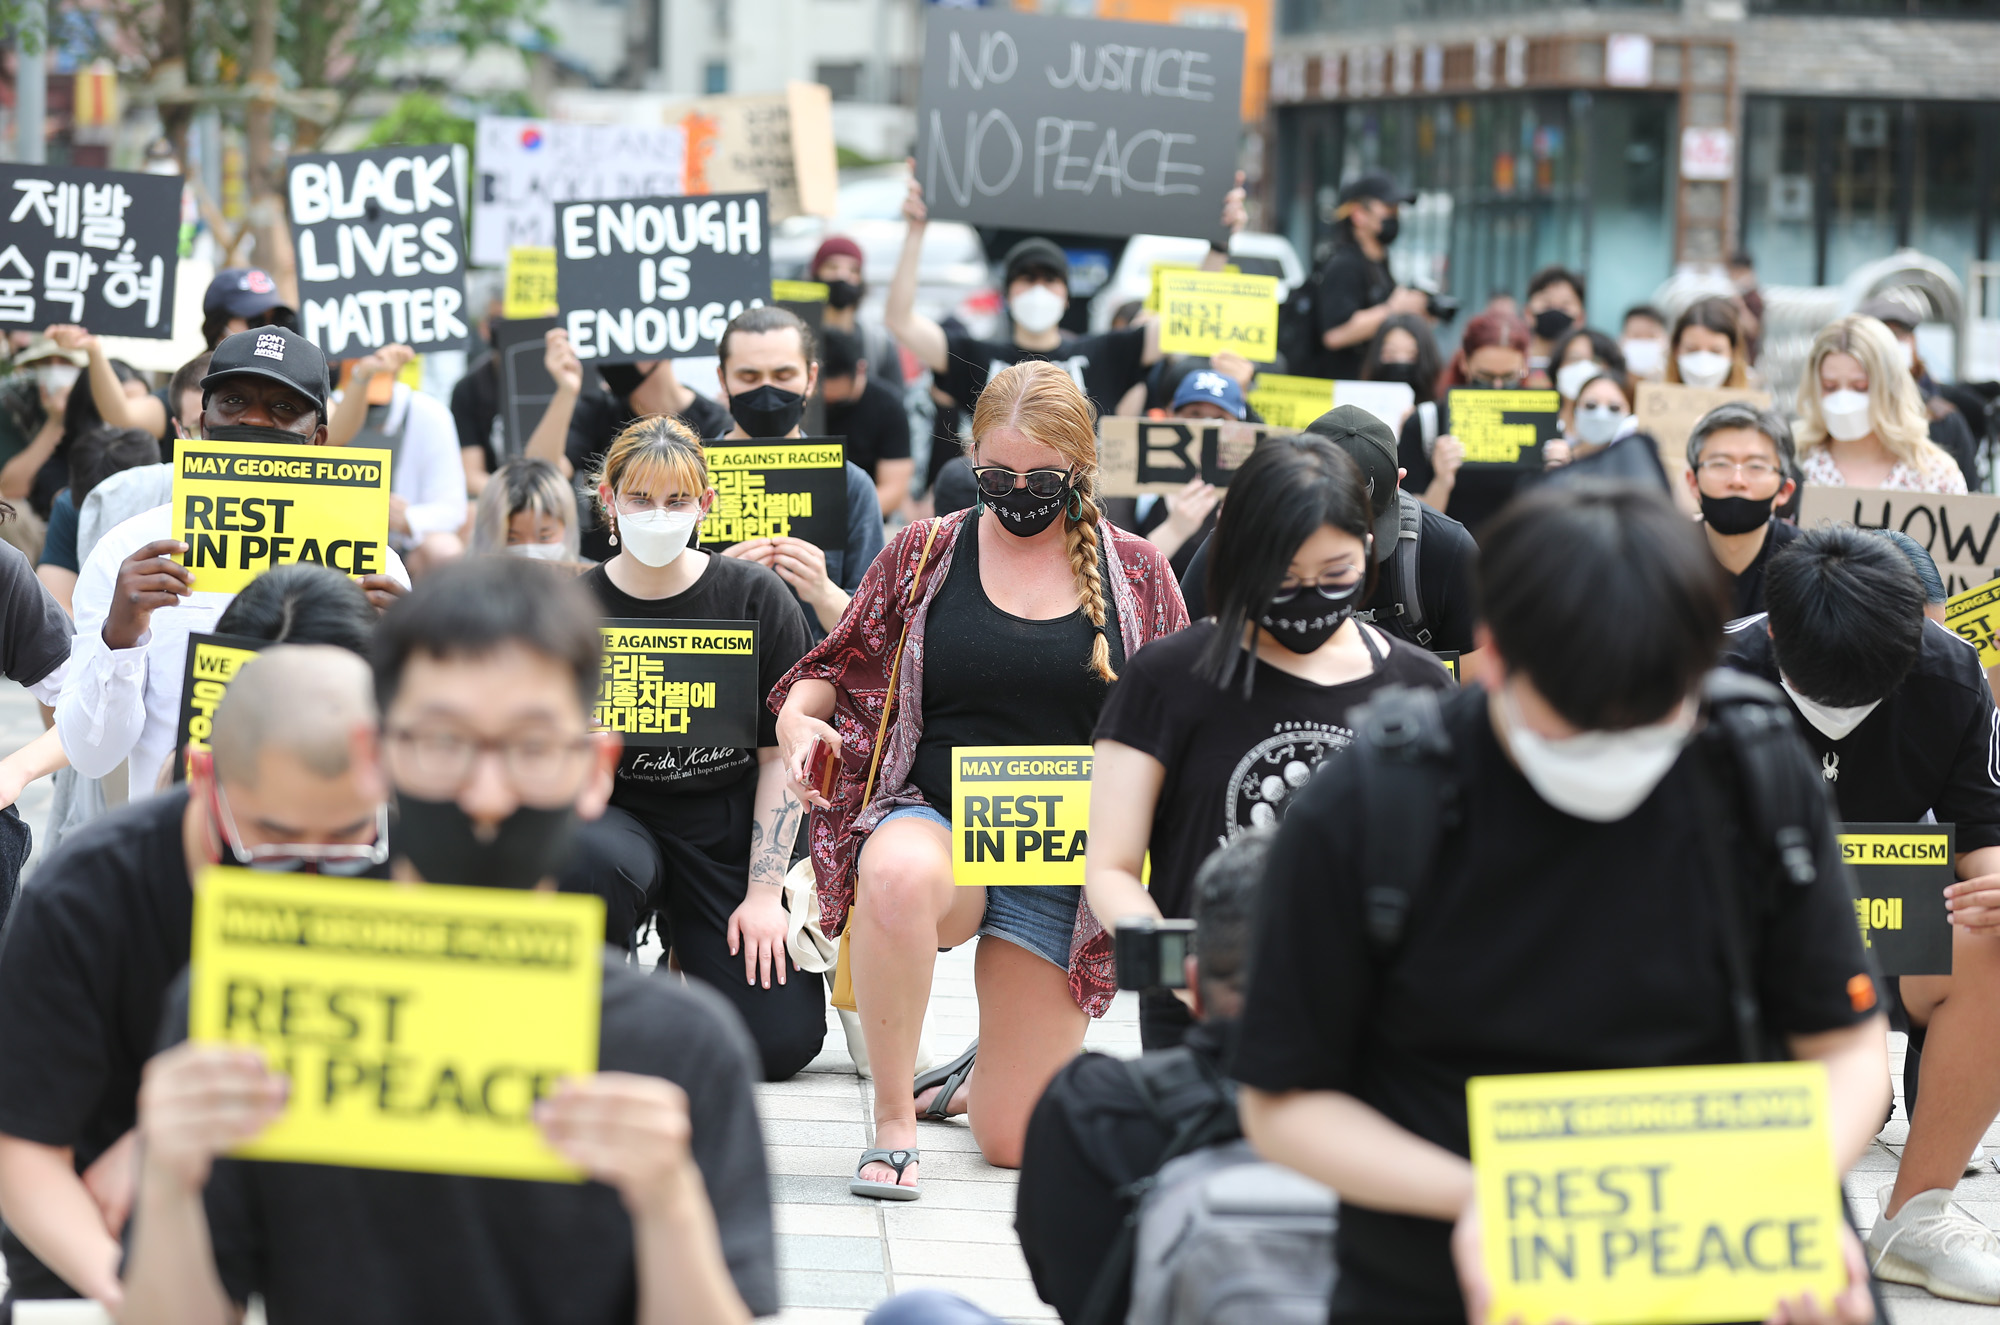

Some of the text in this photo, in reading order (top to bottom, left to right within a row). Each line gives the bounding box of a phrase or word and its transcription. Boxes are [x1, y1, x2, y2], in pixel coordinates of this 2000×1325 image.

[948, 30, 1216, 102] NO JUSTICE
[925, 107, 1205, 208] NO PEACE
[289, 153, 455, 226] BLACK
[562, 198, 762, 260] ENOUGH
[299, 216, 459, 283] LIVES
[0, 243, 165, 329] 숨막혀
[638, 255, 692, 305] IS
[303, 285, 469, 355] MATTER
[1168, 319, 1269, 345] IN PEACE
[256, 340, 286, 353] UPSET
[184, 456, 380, 482] MAY GEORGE FLOYD
[722, 452, 784, 466] AGAINST
[788, 451, 842, 464] RACISM
[185, 495, 294, 534] REST
[183, 533, 228, 569] IN
[1946, 591, 1992, 619] EORGE
[617, 635, 688, 649] AGAINST
[691, 636, 752, 651] RACISM
[1951, 614, 1990, 641] ST
[199, 653, 233, 675] WE
[631, 751, 676, 770] Frida
[681, 767, 693, 778] and
[697, 766, 714, 776] hope
[714, 762, 730, 772] never
[961, 760, 1004, 776] MAY
[1006, 760, 1078, 776] GEORGE
[964, 795, 1064, 828] REST
[964, 830, 1089, 863] IN PEA
[1872, 843, 1946, 859] RACISM
[222, 977, 418, 1045] REST
[1504, 1162, 1674, 1220] REST
[1508, 1215, 1826, 1284] IN PEACE
